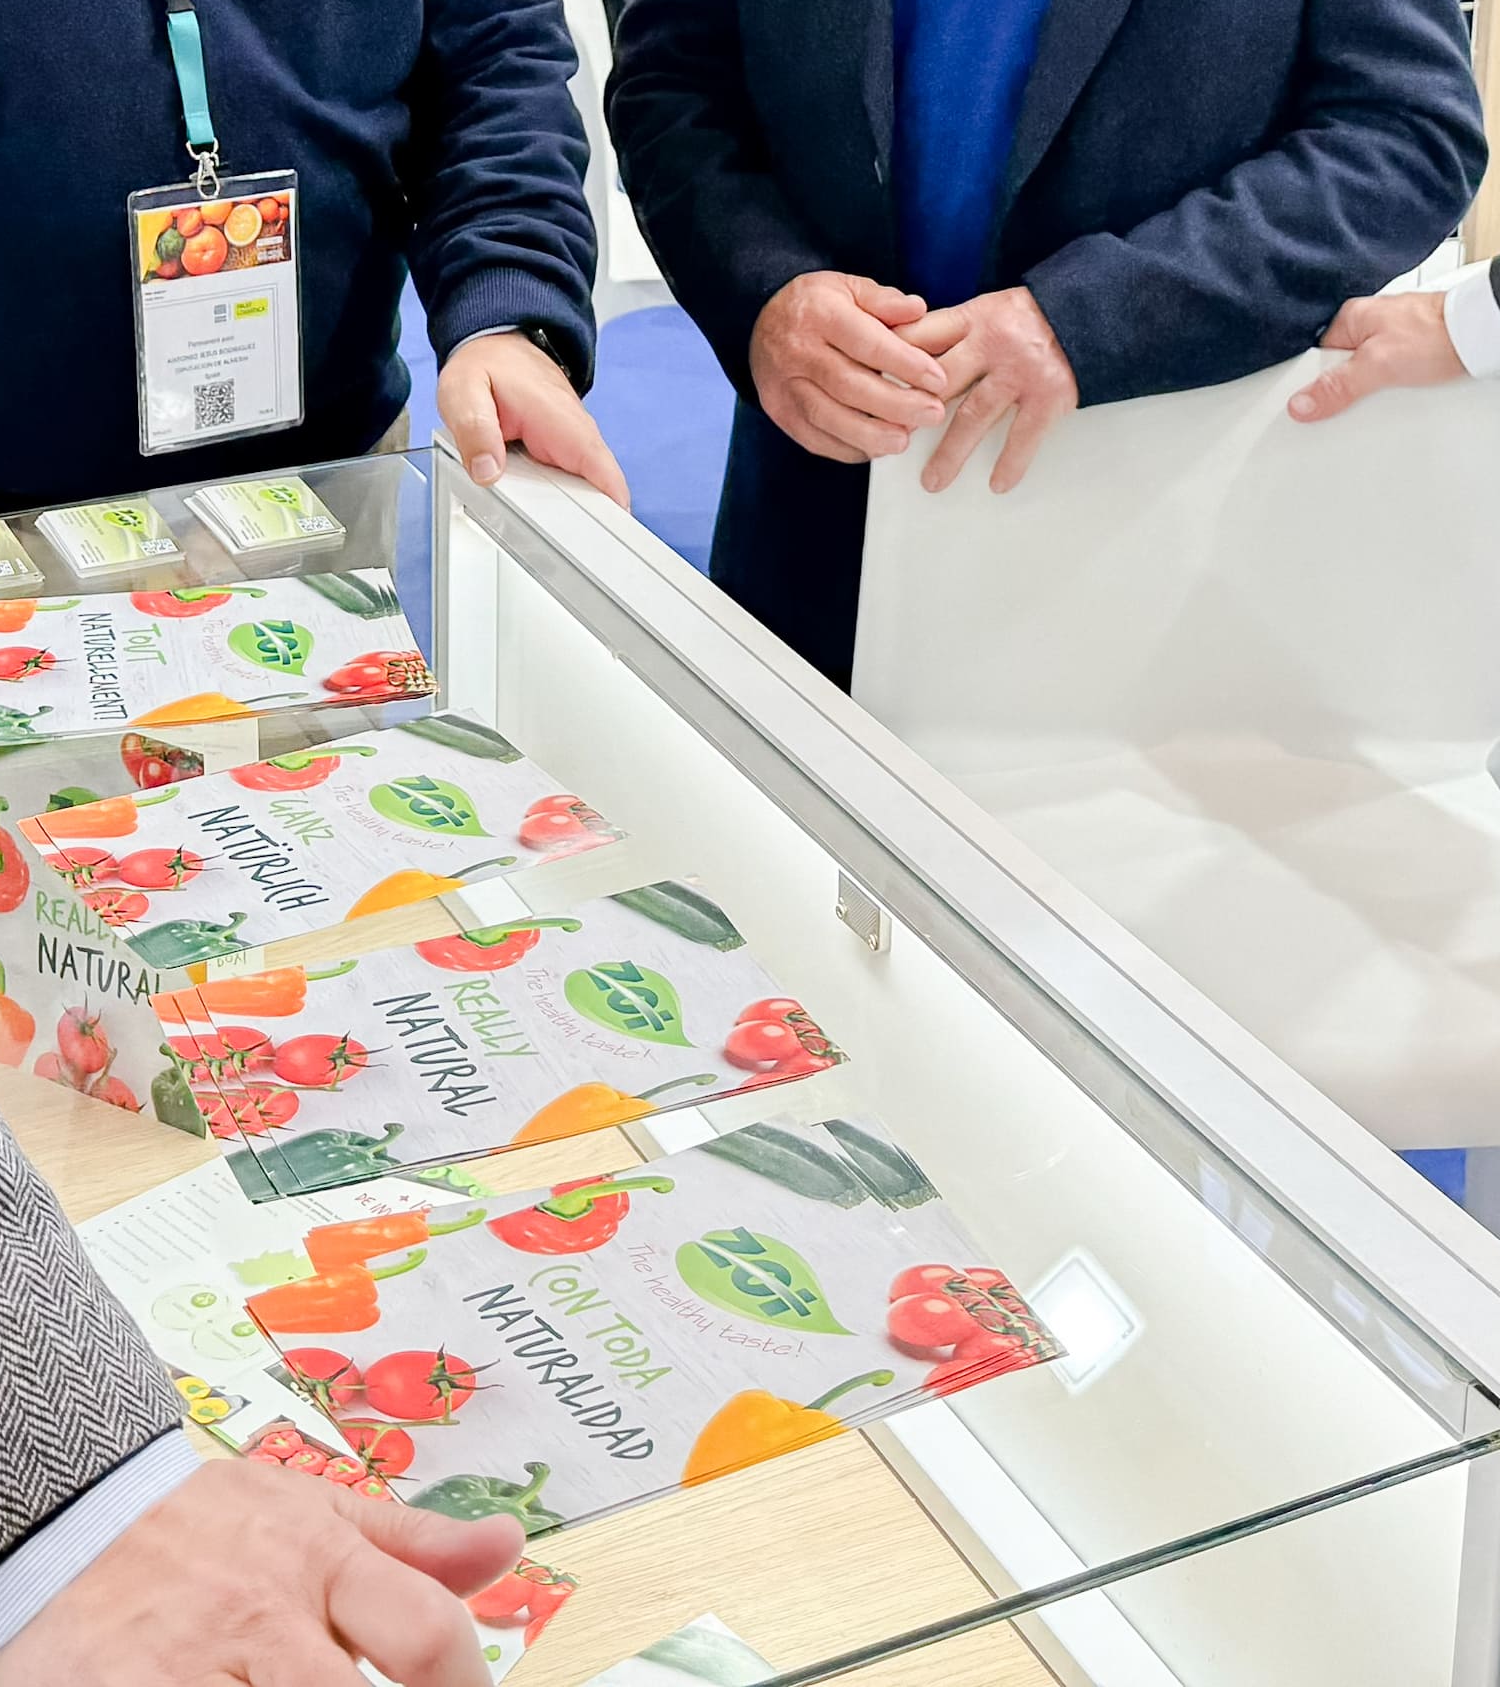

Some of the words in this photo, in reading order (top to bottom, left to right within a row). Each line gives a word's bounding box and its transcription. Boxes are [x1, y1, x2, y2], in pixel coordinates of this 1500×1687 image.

[121, 622, 168, 666] TOUT
[187, 803, 330, 912] NATÜRLICH
[268, 799, 336, 847] GANZ
[372, 991, 498, 1117] NATURAL
[443, 978, 541, 1058] REALLY
[527, 1262, 612, 1317] CON
[585, 1311, 674, 1391] TODA
[626, 1240, 654, 1275] The
[642, 1272, 714, 1333] healthy
[717, 1324, 805, 1359] taste!
[461, 1282, 655, 1461] NATURALIDAD
